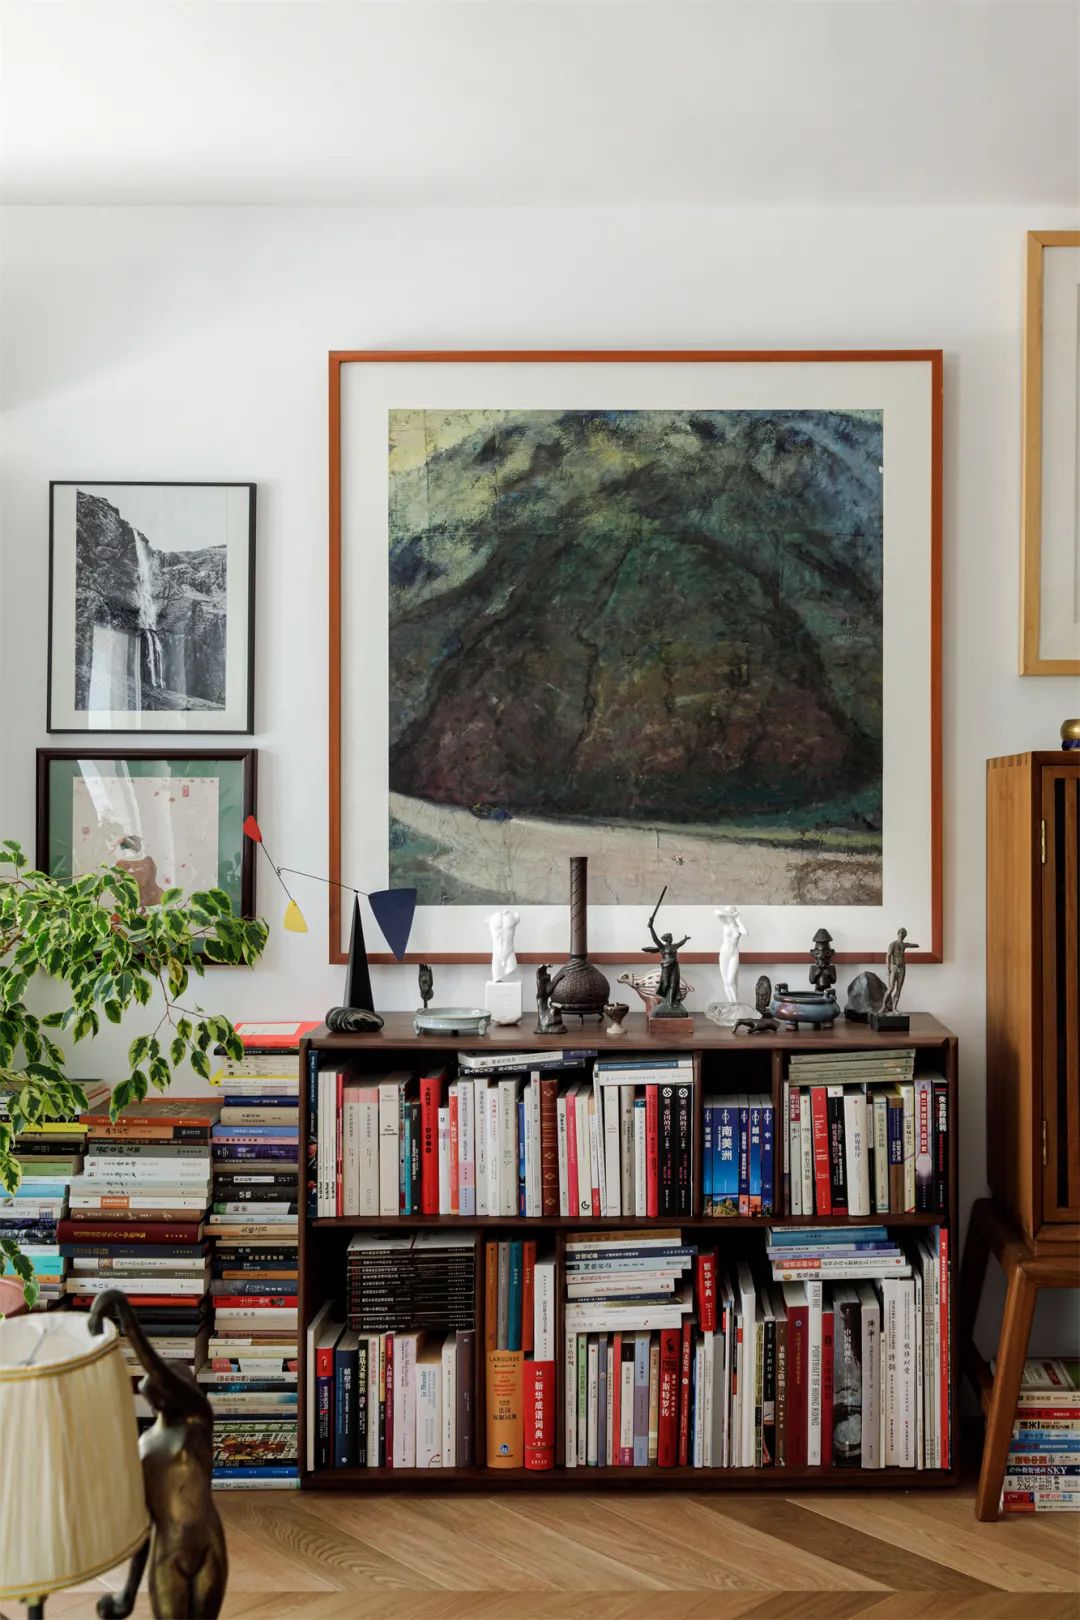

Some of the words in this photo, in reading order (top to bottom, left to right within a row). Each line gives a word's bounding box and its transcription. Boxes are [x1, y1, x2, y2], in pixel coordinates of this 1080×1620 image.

[722, 1126, 733, 1161] 南美洲
[752, 1126, 760, 1144] 越南
[704, 1262, 712, 1298] 新华字典
[812, 1299, 820, 1308] HO
[811, 1345, 820, 1376] PORTRAIT
[661, 1374, 670, 1417] 卡斯特罗传
[811, 1387, 819, 1406] HONG
[534, 1381, 544, 1439] 新华成语词典
[811, 1408, 819, 1426] KONG
[1047, 1466, 1067, 1474] SKY
